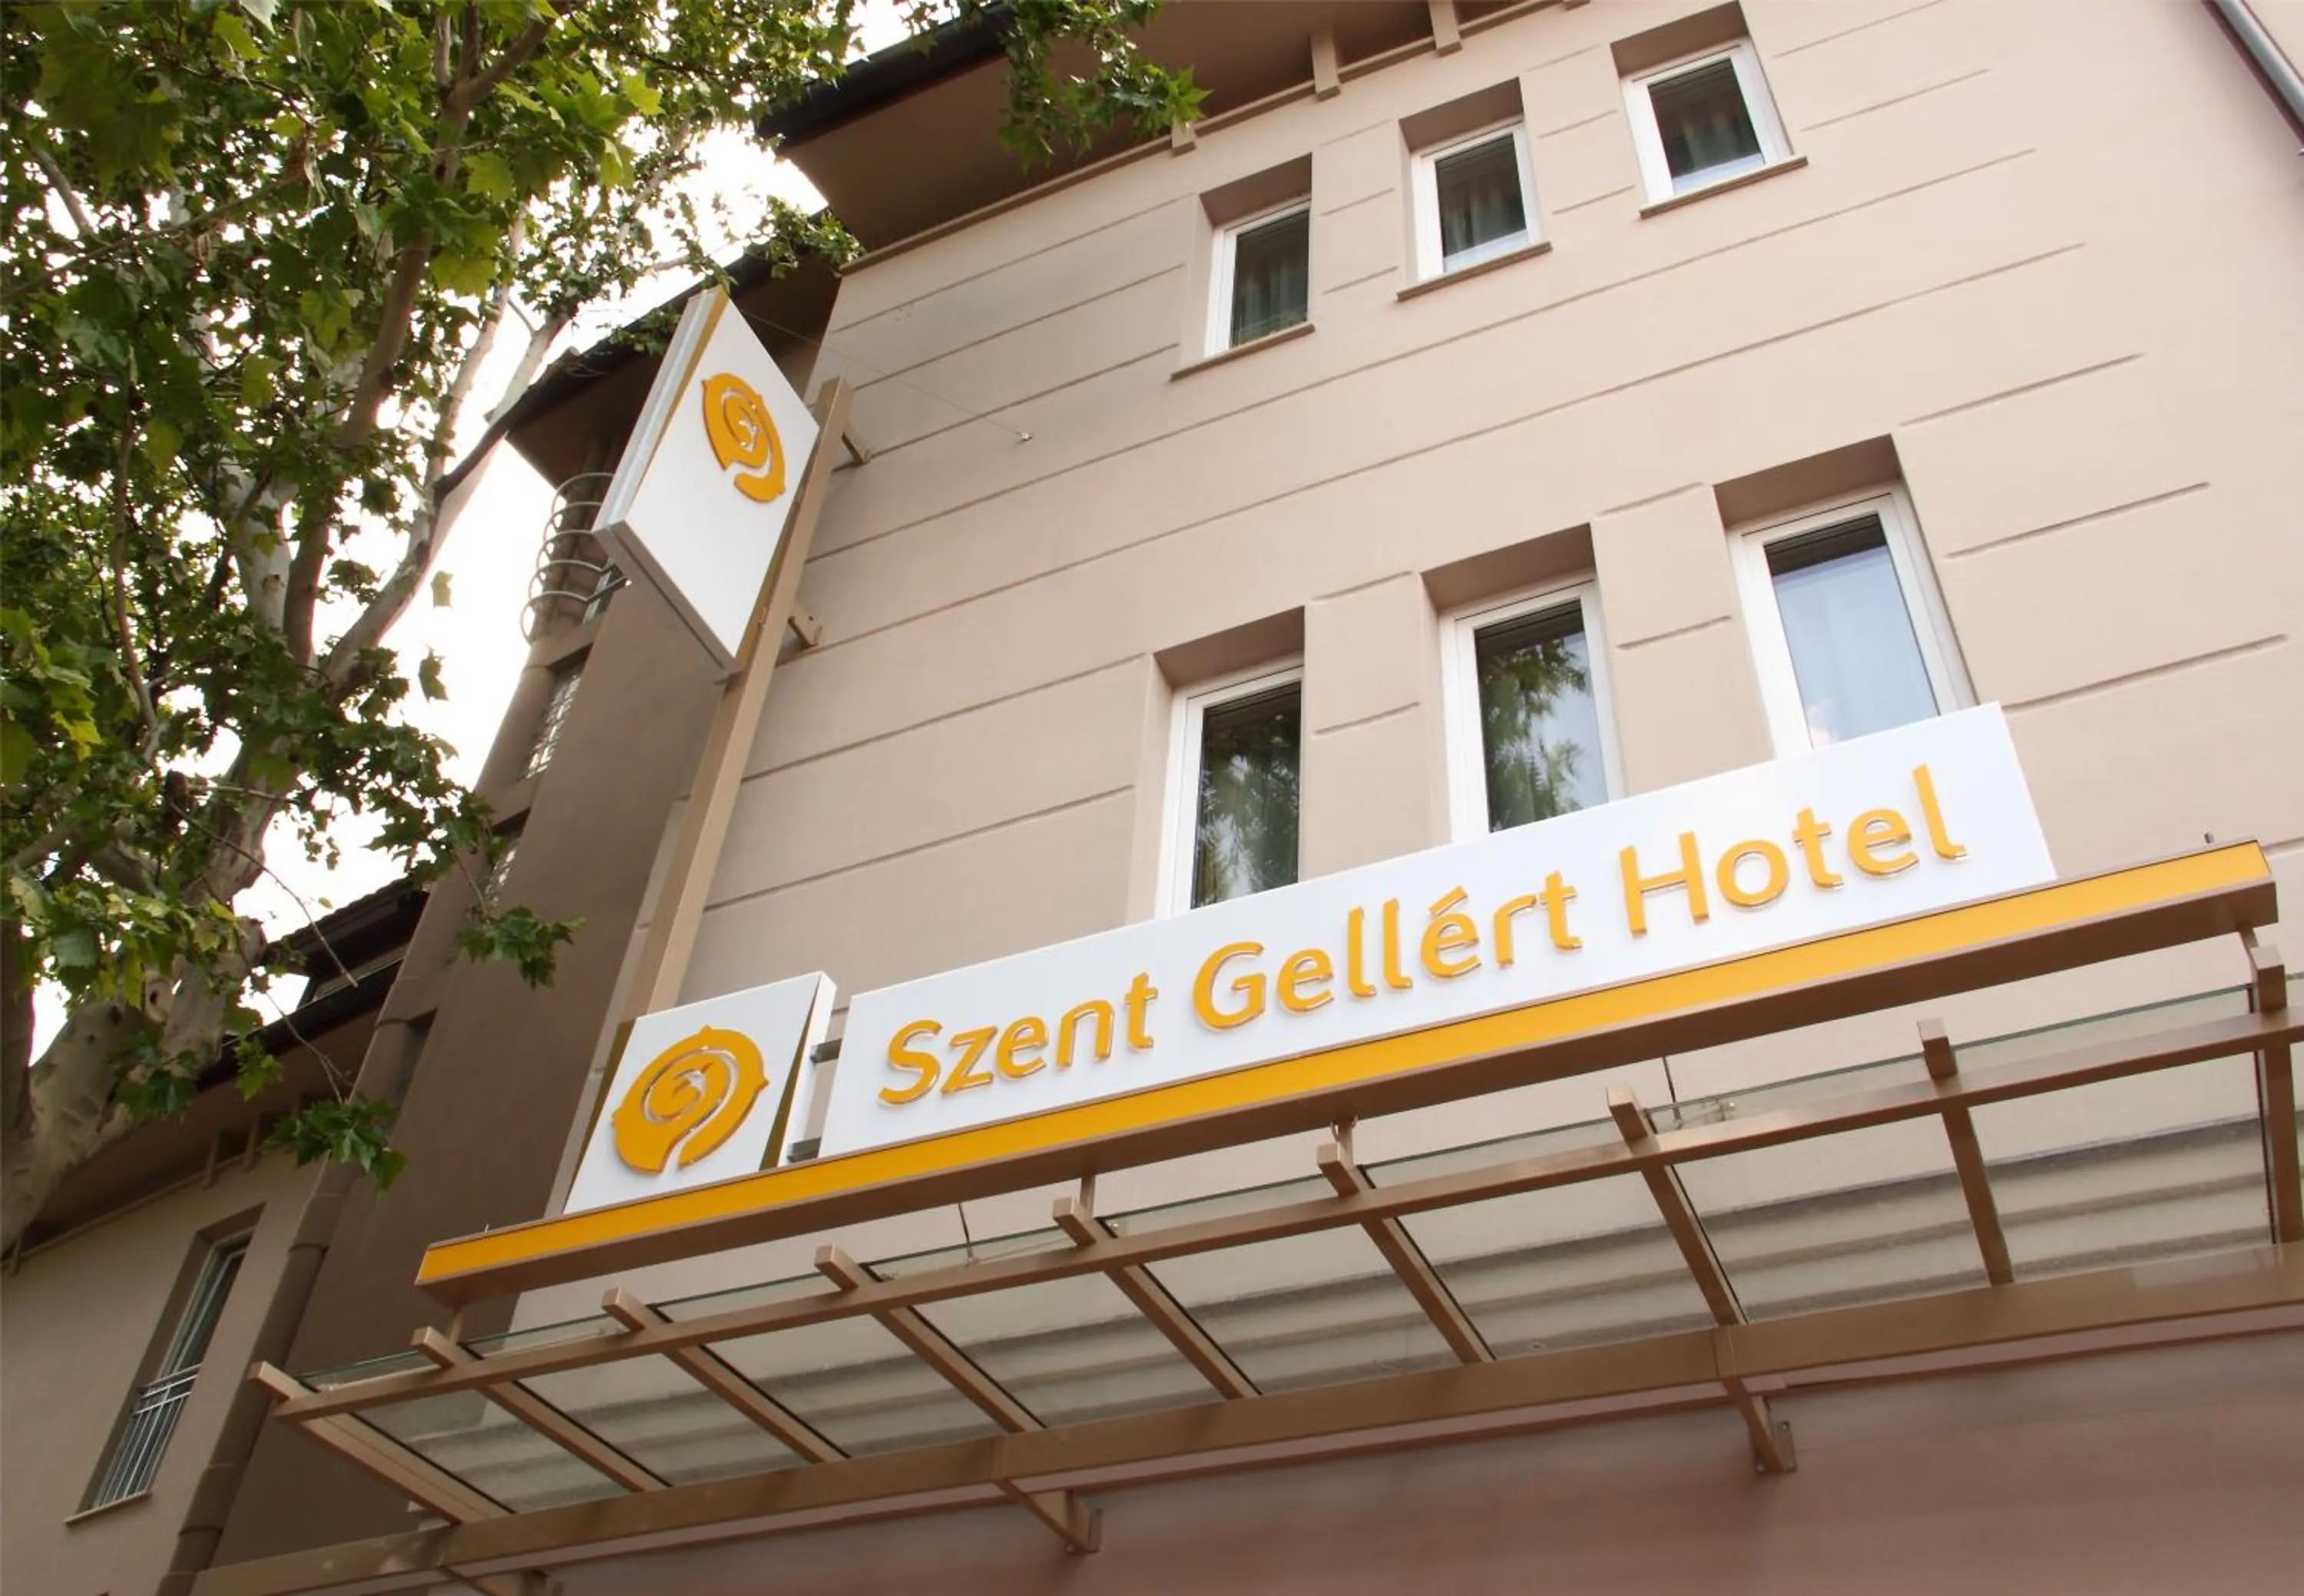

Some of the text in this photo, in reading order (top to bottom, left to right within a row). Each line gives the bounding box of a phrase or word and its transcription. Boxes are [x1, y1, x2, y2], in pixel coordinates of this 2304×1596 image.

[878, 763, 1967, 1106] Szent Gellért Hotel
